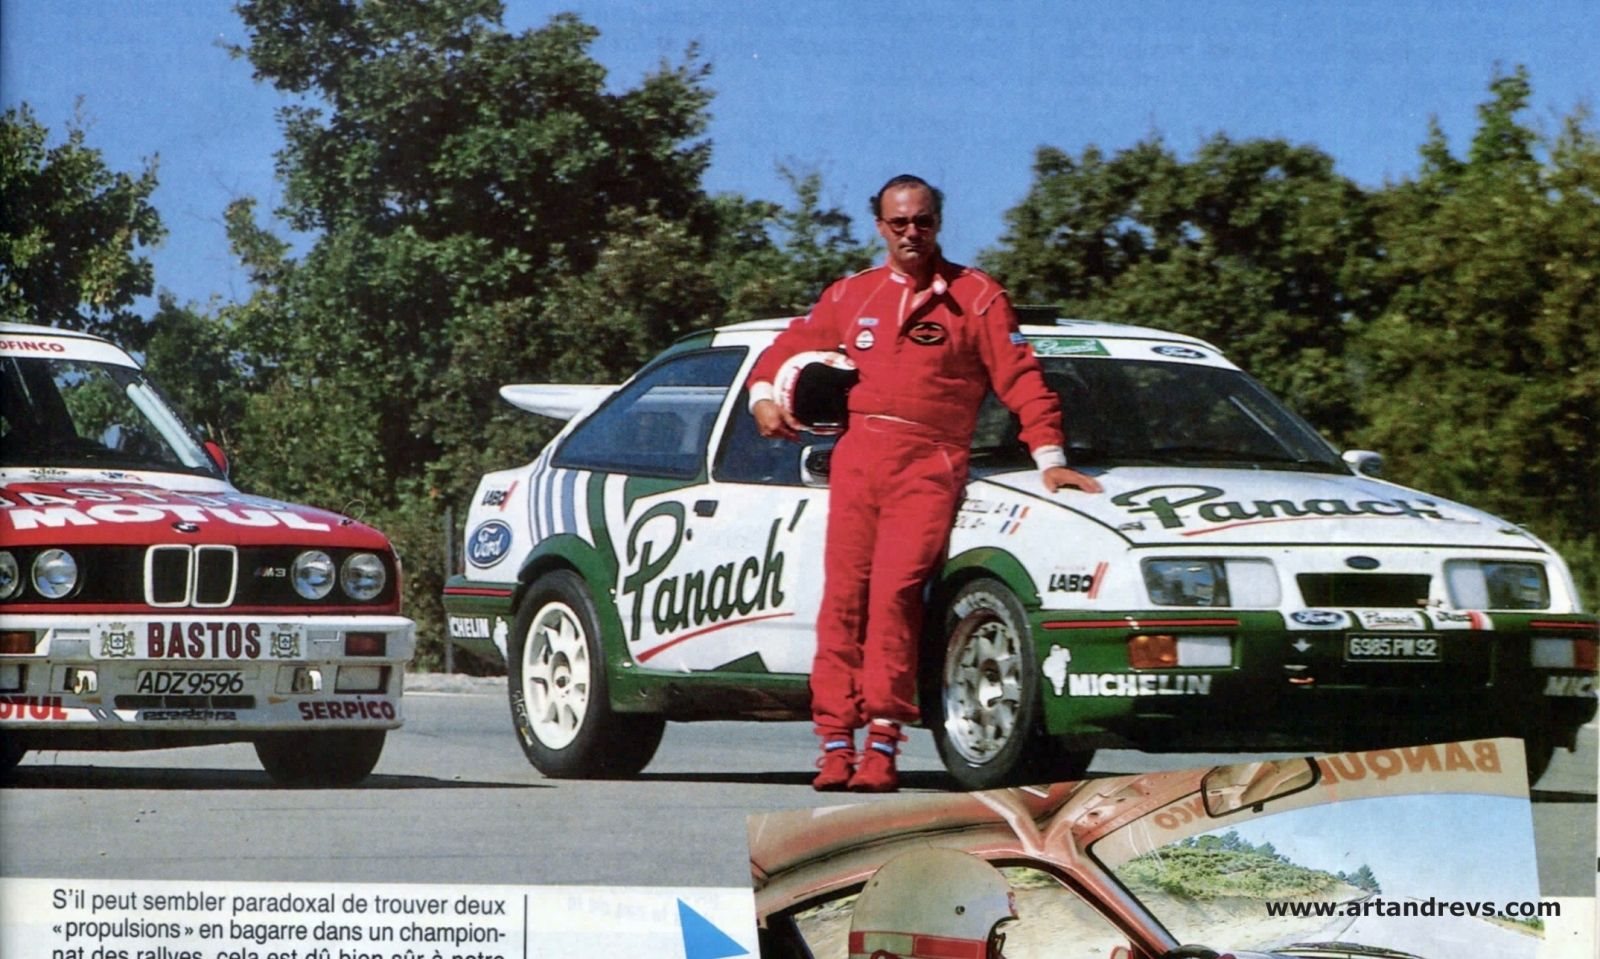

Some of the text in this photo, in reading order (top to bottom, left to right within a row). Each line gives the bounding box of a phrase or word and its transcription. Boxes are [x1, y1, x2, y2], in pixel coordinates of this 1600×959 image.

[9, 504, 331, 532] MOTUL
[472, 524, 506, 561] Ford
[147, 622, 261, 659] BASTOS
[1069, 673, 1212, 696] MICHELIN
[298, 701, 396, 720] SERPICO
[92, 891, 137, 914] peut
[143, 891, 226, 911] sembler
[232, 893, 335, 917] paradoxal
[342, 893, 368, 914] de
[374, 894, 449, 914] trouver
[454, 894, 506, 915] deux
[199, 922, 223, 939] en
[229, 919, 308, 945] bagarre
[313, 920, 363, 941] dans
[369, 925, 394, 941] un
[400, 921, 506, 947] champion-
